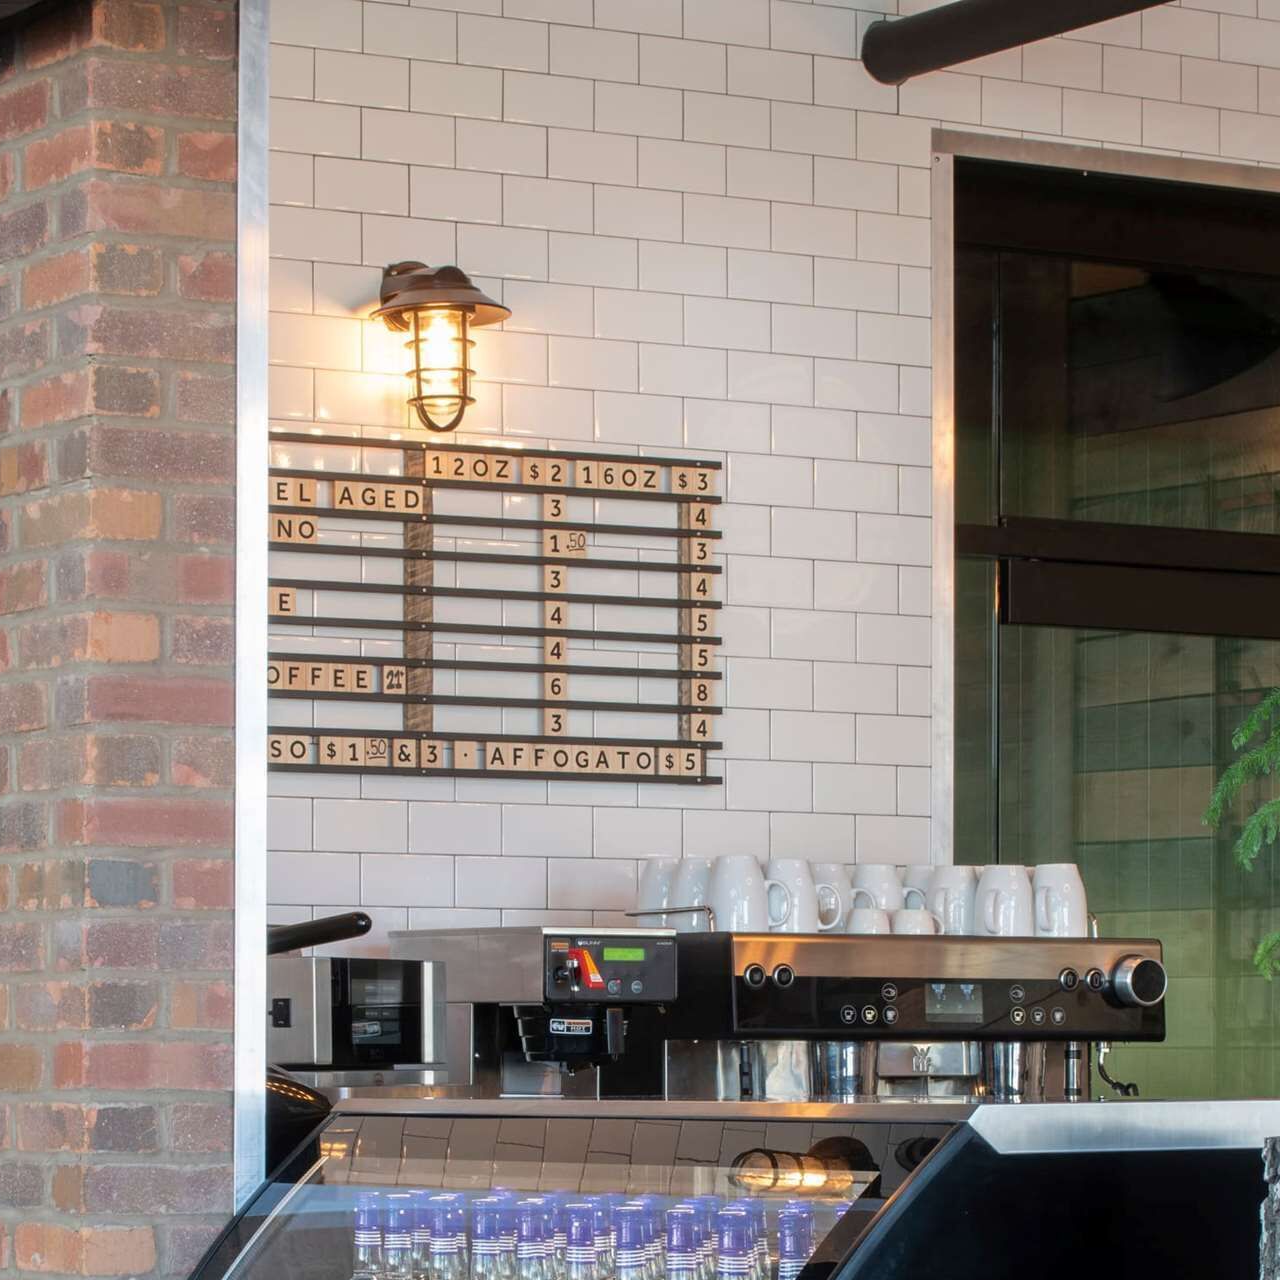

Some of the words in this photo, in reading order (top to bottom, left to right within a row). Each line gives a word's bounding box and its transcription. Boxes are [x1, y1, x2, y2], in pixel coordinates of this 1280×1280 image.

[530, 464, 562, 482] $2
[678, 473, 708, 491] $3
[276, 483, 311, 502] EL
[339, 486, 420, 508] AGED
[551, 500, 562, 517] 3
[695, 508, 707, 526] 4
[277, 519, 315, 539] NO
[696, 543, 707, 560] 3
[550, 571, 561, 588] 3
[696, 579, 708, 596] 4
[279, 593, 291, 611] E
[550, 607, 562, 624] 4
[697, 614, 708, 631] 5
[550, 642, 562, 660] 4
[697, 649, 708, 667] 5
[551, 678, 562, 695] 6
[697, 684, 708, 701] 8
[551, 714, 562, 732] 3
[696, 720, 708, 737] 4
[270, 740, 306, 759] SO
[426, 746, 438, 763] 3
[490, 748, 652, 770] AFFOGATO
[665, 753, 696, 770] $5
